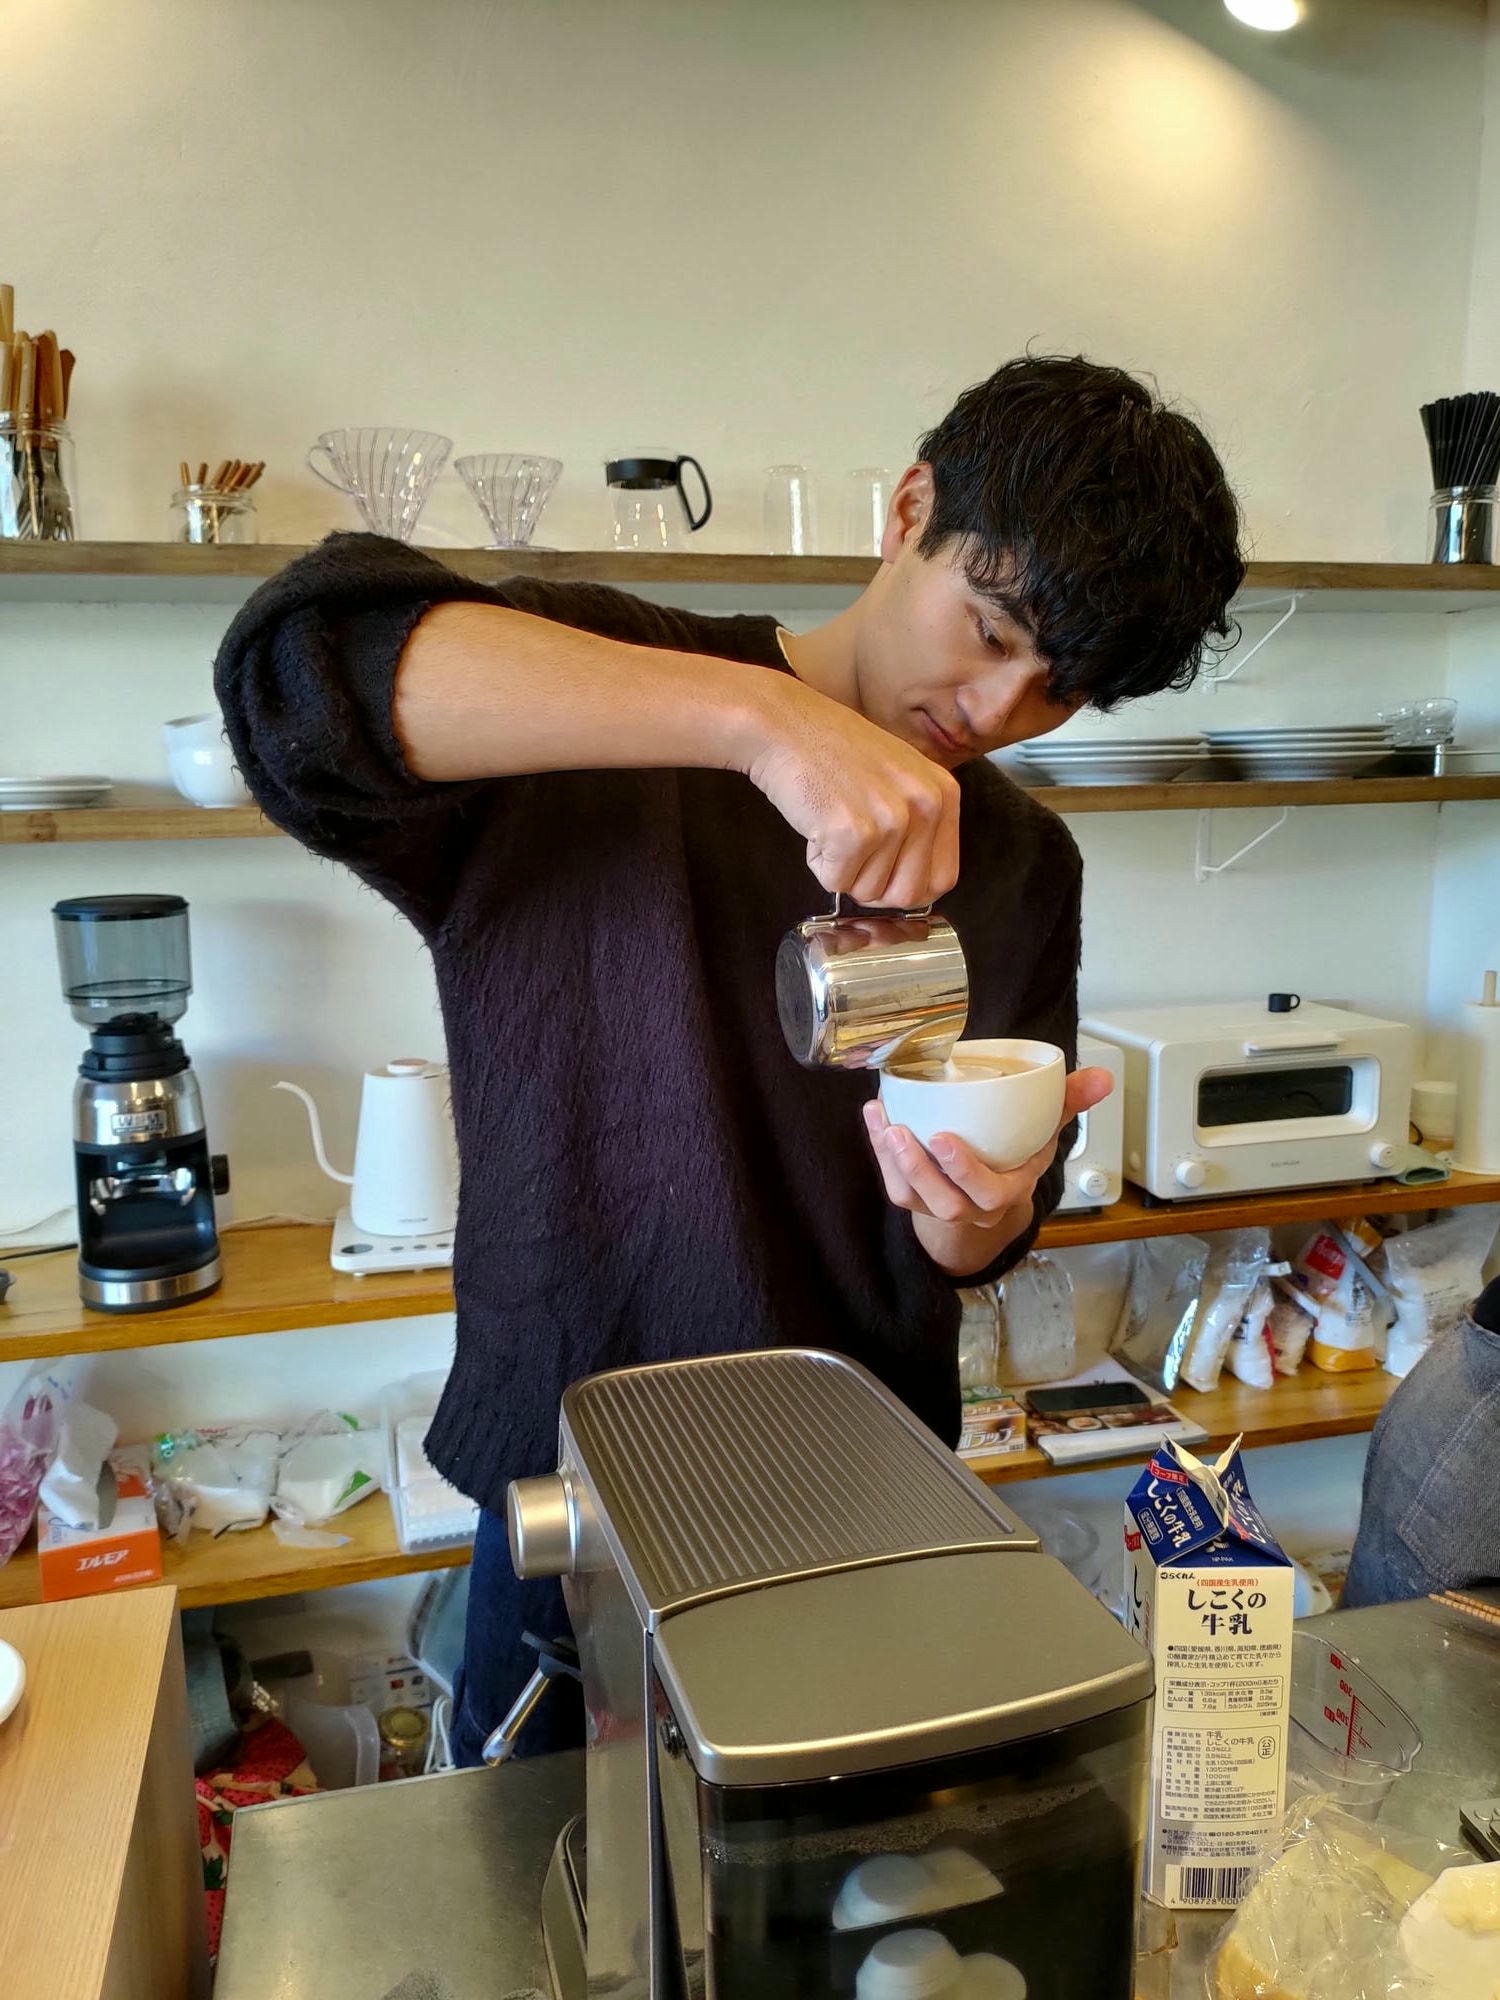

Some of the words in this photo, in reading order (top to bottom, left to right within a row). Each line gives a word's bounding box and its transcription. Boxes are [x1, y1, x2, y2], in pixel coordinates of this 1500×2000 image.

[1147, 1478, 1192, 1548] しこくの牛乳
[1169, 1571, 1196, 1580] らくれん
[1187, 1588, 1267, 1611] しこくの
[1201, 1612, 1253, 1636] 牛乳
[1206, 1730, 1223, 1738] 牛乳
[1207, 1737, 1255, 1746] しこくの牛乳
